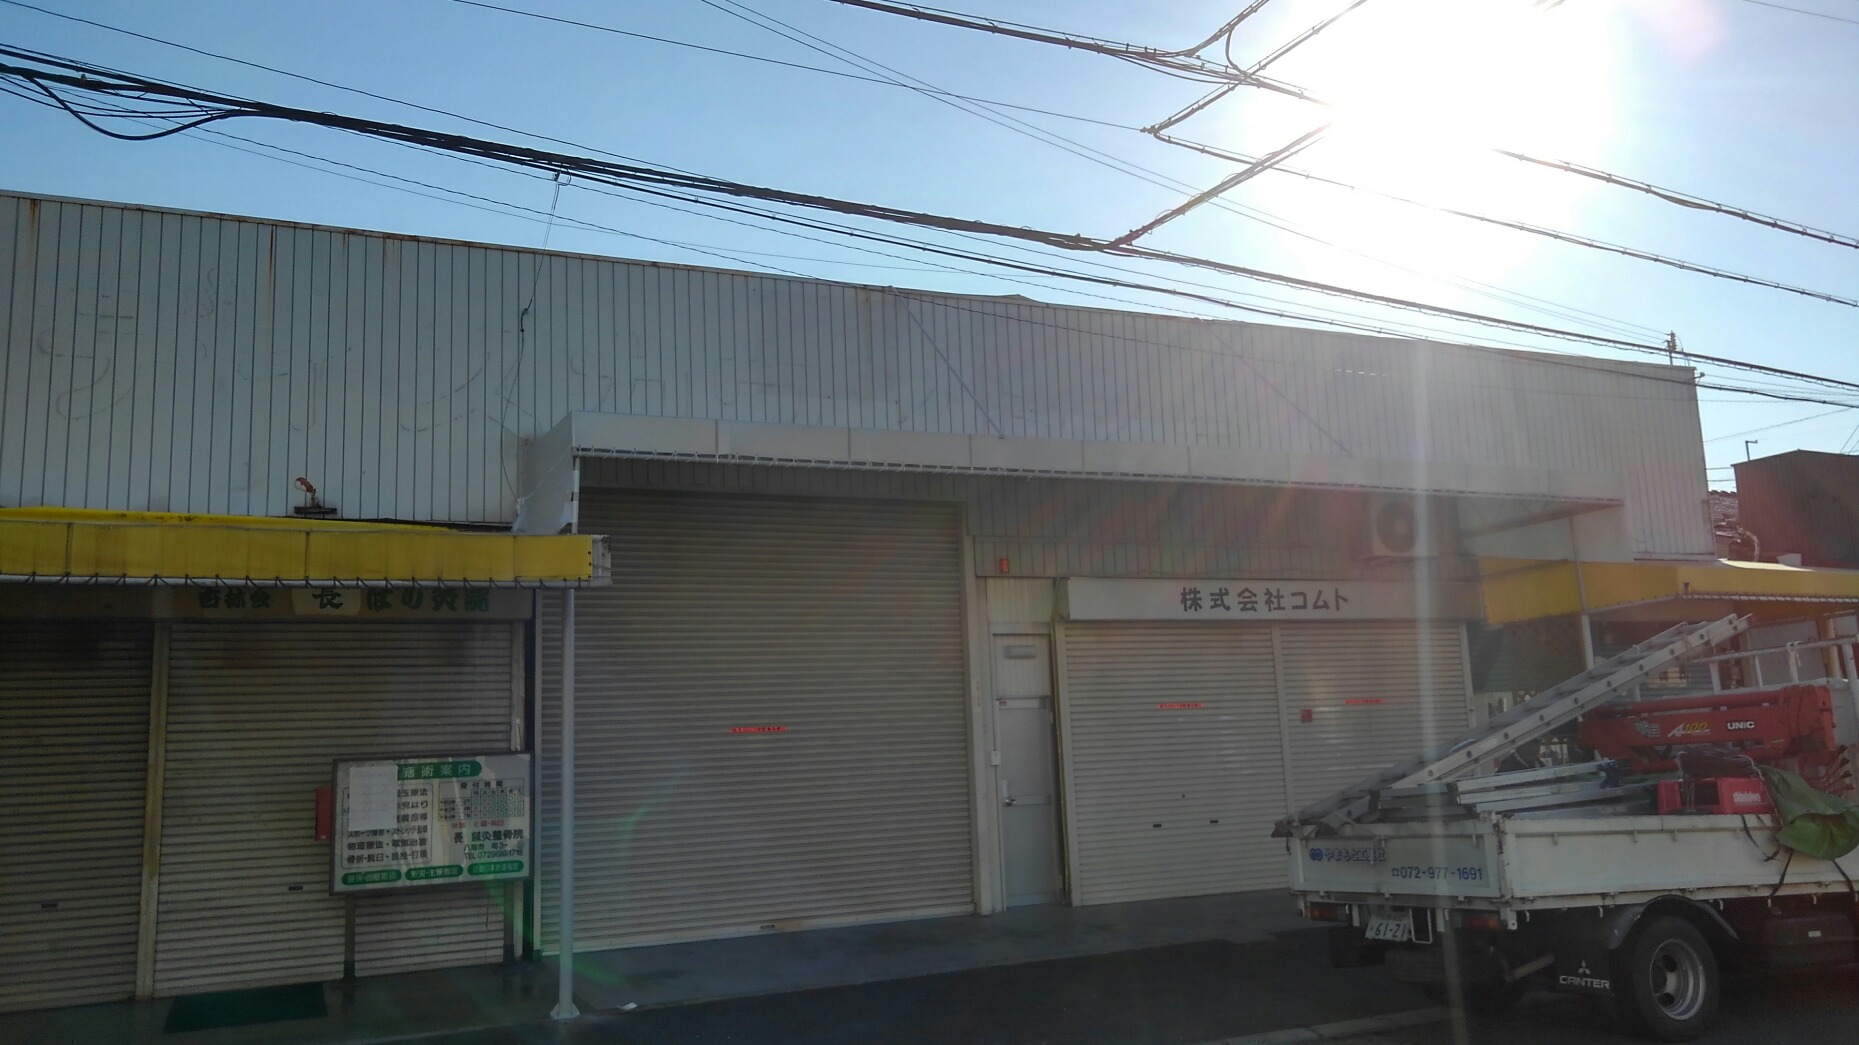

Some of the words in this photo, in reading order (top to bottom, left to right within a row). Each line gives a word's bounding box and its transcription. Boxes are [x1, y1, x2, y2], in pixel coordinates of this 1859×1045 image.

[312, 588, 343, 610] 長
[1180, 587, 1349, 612] 株式会社コムト
[1727, 720, 1755, 730] UNIC
[1400, 866, 1483, 881] 072-977-1691
[1374, 922, 1407, 938] 61-21
[1559, 975, 1610, 990] CANTER
